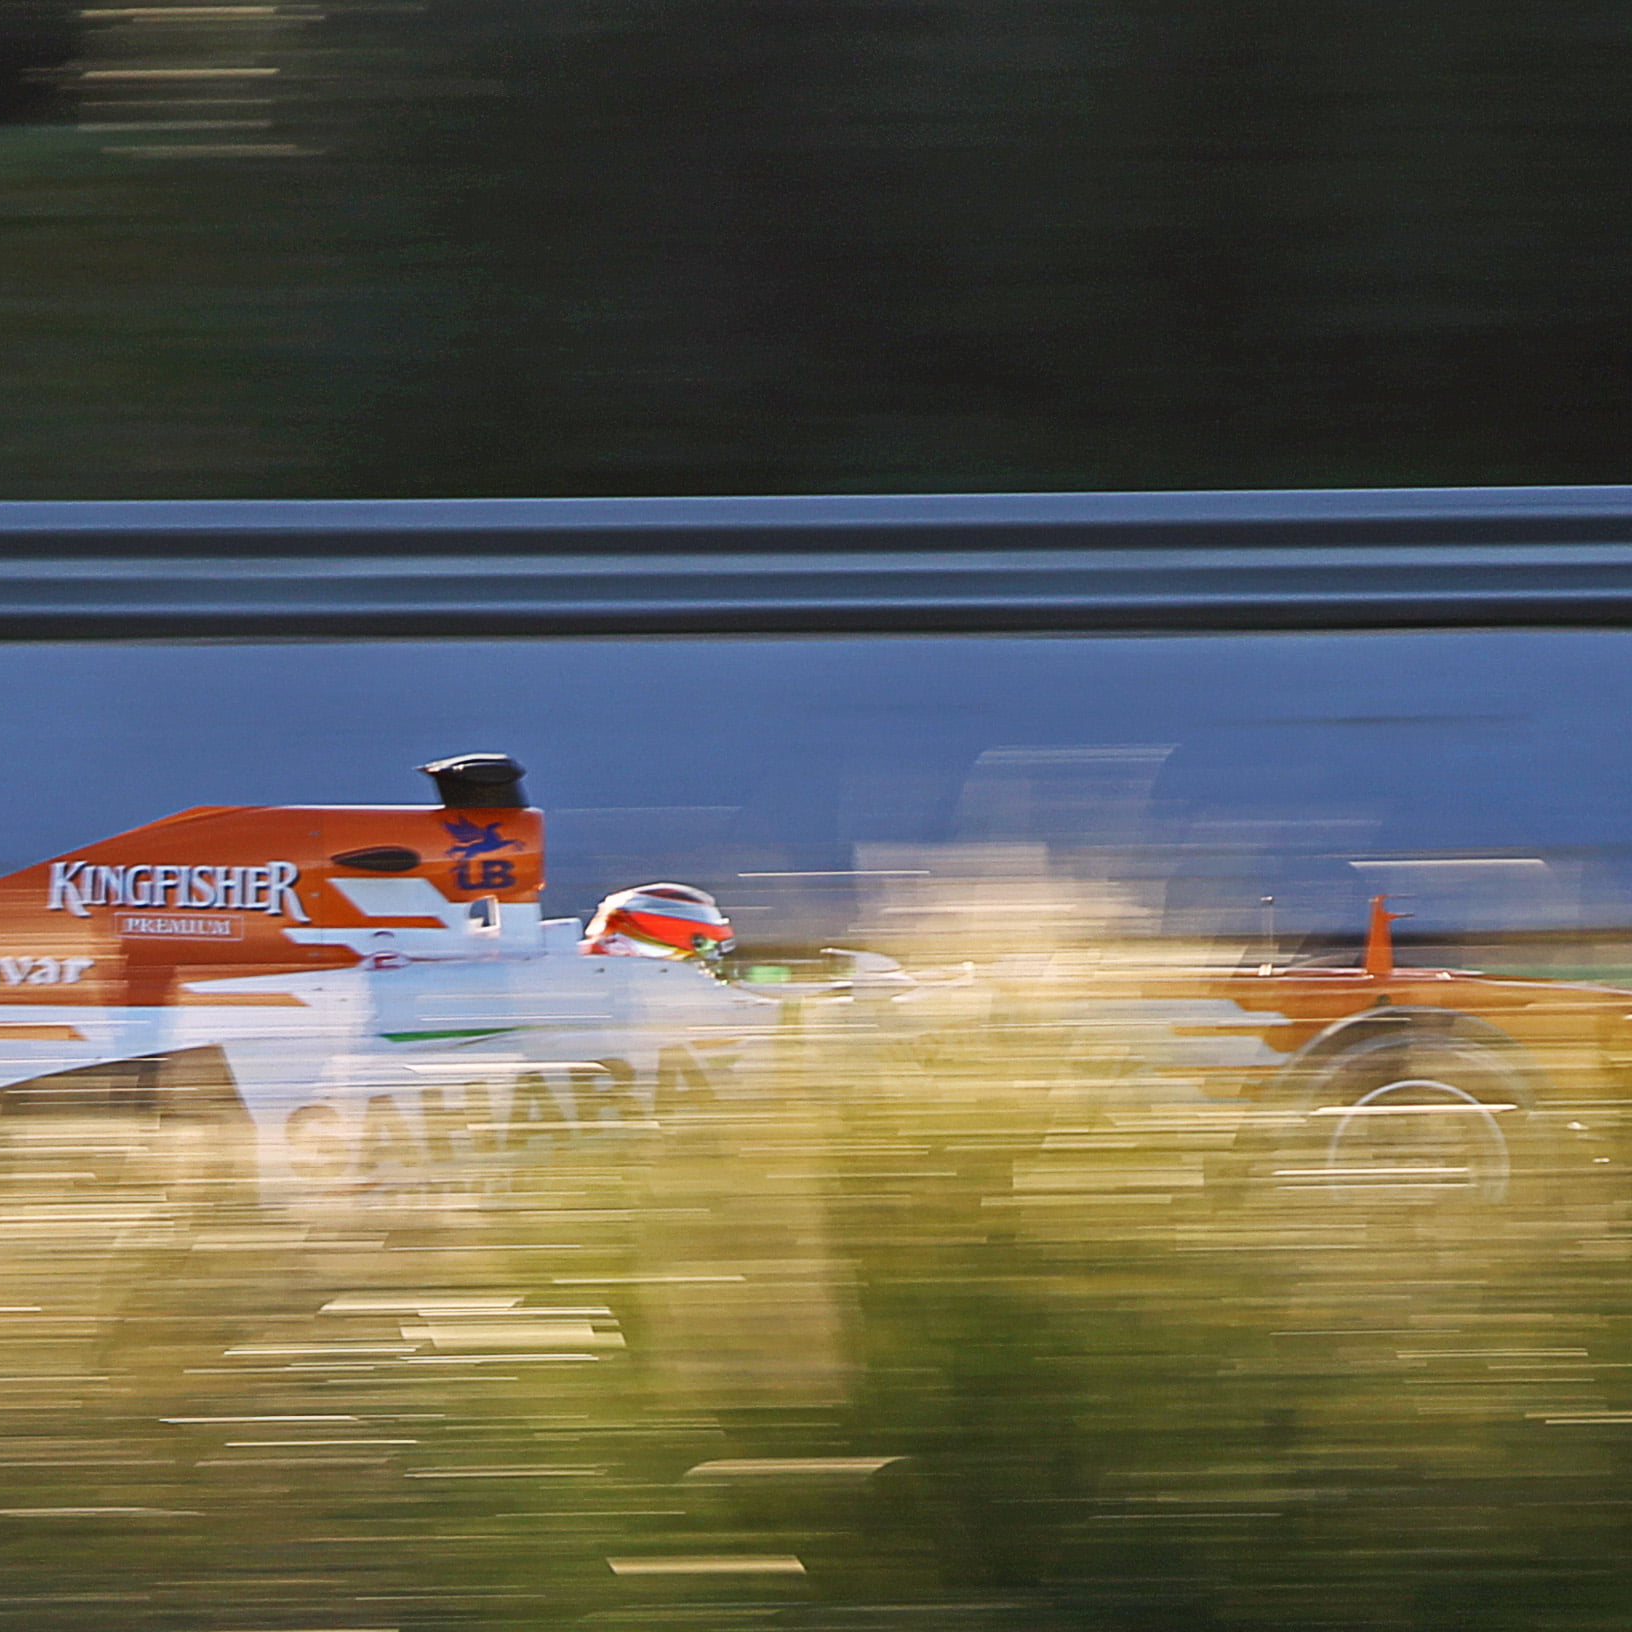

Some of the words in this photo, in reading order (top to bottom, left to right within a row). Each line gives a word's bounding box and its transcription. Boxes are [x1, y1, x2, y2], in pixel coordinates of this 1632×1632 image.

[46, 860, 310, 922] KINGFISHER
[450, 859, 516, 890] UB
[123, 917, 232, 936] PREMIUM
[285, 1043, 718, 1179] SAHARA
